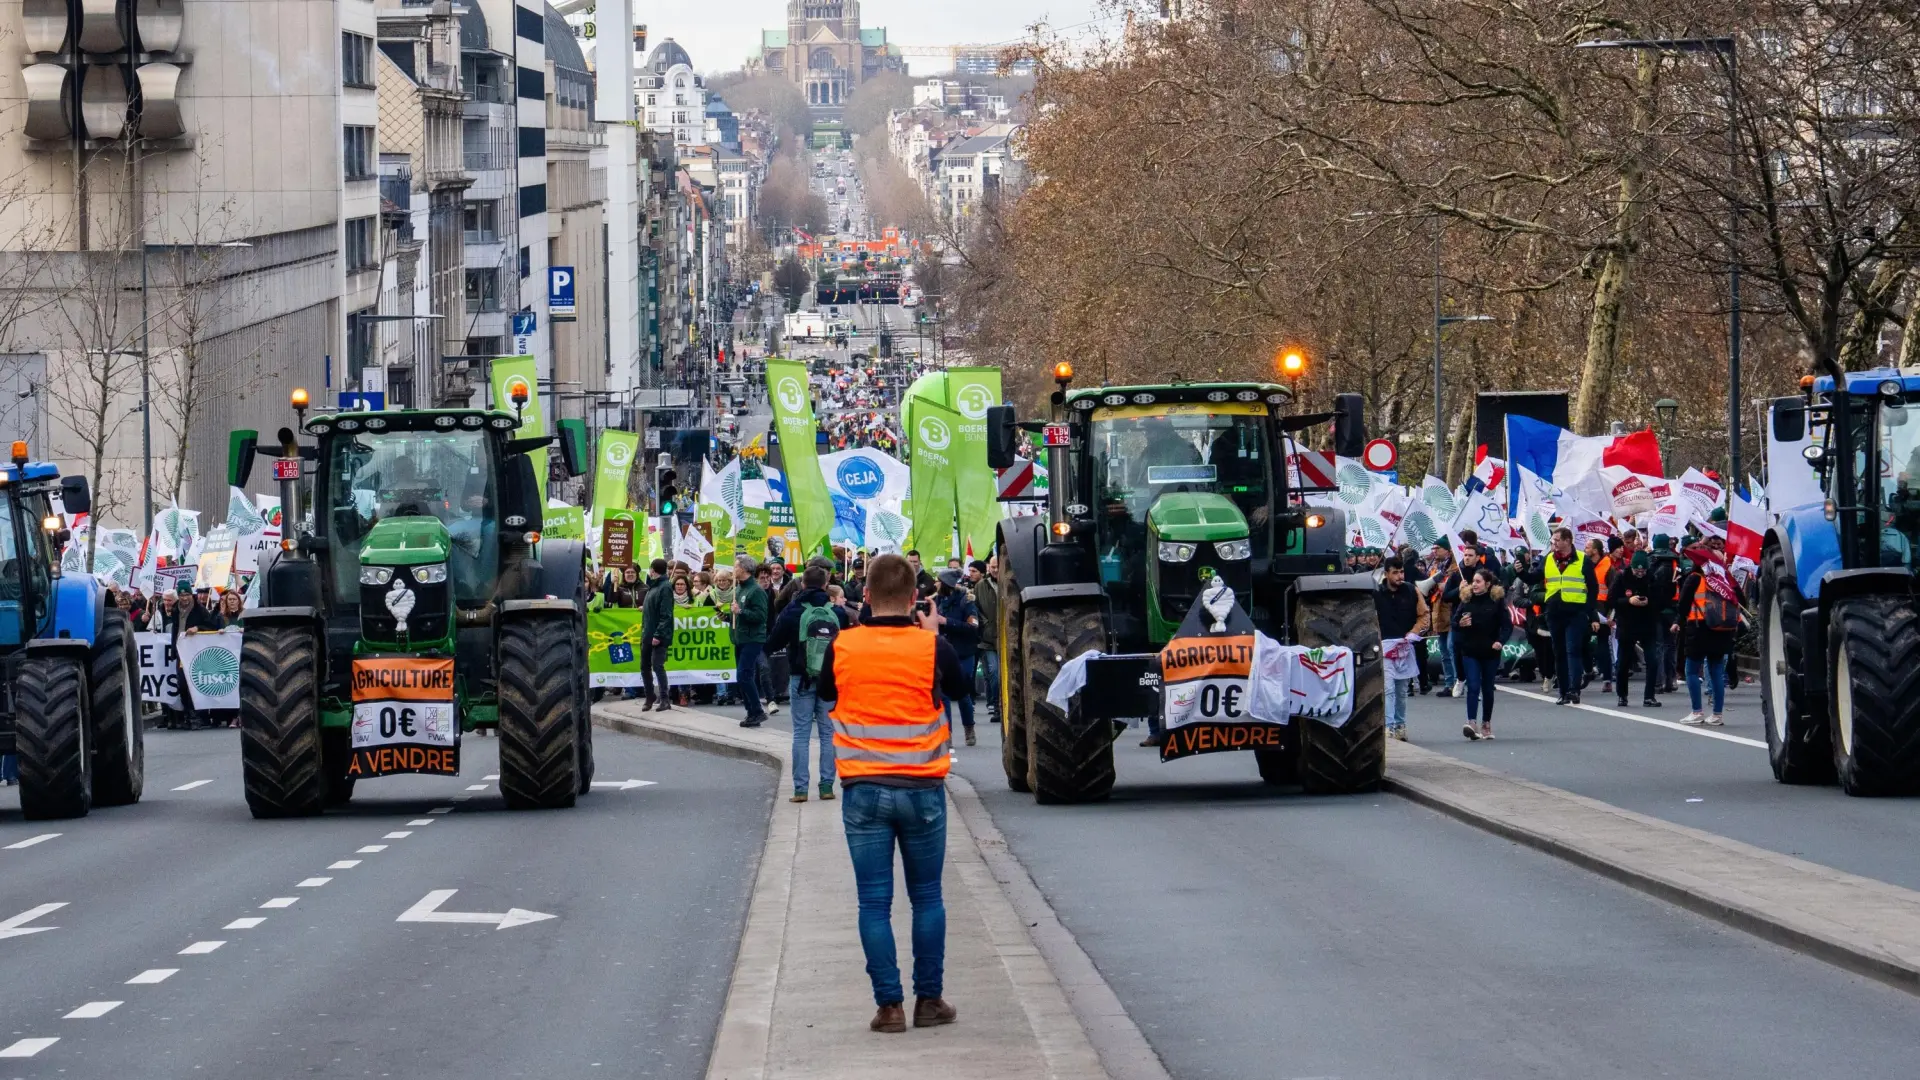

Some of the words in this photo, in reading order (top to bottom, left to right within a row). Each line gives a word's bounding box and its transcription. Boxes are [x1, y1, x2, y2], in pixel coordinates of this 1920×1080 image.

[553, 271, 570, 295] P
[958, 425, 988, 433] BOERE
[918, 448, 948, 465] BOEREN
[845, 471, 878, 486] CEJA
[1616, 480, 1642, 494] Jeunes
[1693, 483, 1717, 500] Jeunes
[781, 506, 788, 514] DE
[543, 516, 567, 528] LOCK
[769, 515, 780, 523] PAS
[1586, 524, 1609, 534] Jeunes
[674, 615, 730, 630] NLOC
[678, 631, 716, 645] OUR
[1165, 645, 1253, 670] AGRICULT
[140, 674, 180, 697] AYS
[197, 670, 234, 685] fnsea
[353, 669, 452, 691] AGRICULTURE
[1200, 684, 1243, 718] 0€
[379, 707, 417, 738] 0€
[1164, 734, 1179, 756] A
[1184, 726, 1281, 751] VENDRE
[349, 753, 363, 775] A
[366, 748, 455, 773] VENDRE
